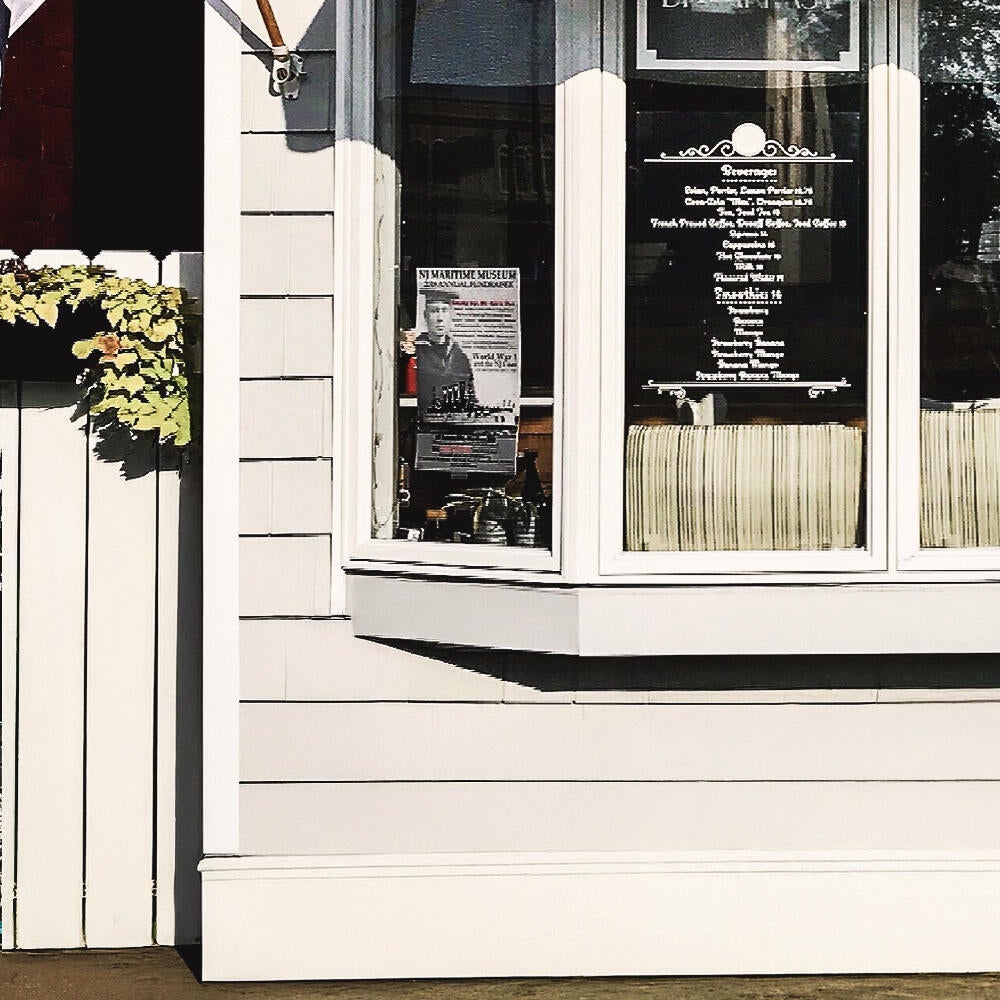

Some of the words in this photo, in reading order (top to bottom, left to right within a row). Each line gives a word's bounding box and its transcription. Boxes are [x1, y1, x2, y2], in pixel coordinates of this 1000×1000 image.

[721, 165, 777, 178] Beverages
[431, 269, 475, 280] MARITIME
[478, 269, 517, 280] MUSEUM
